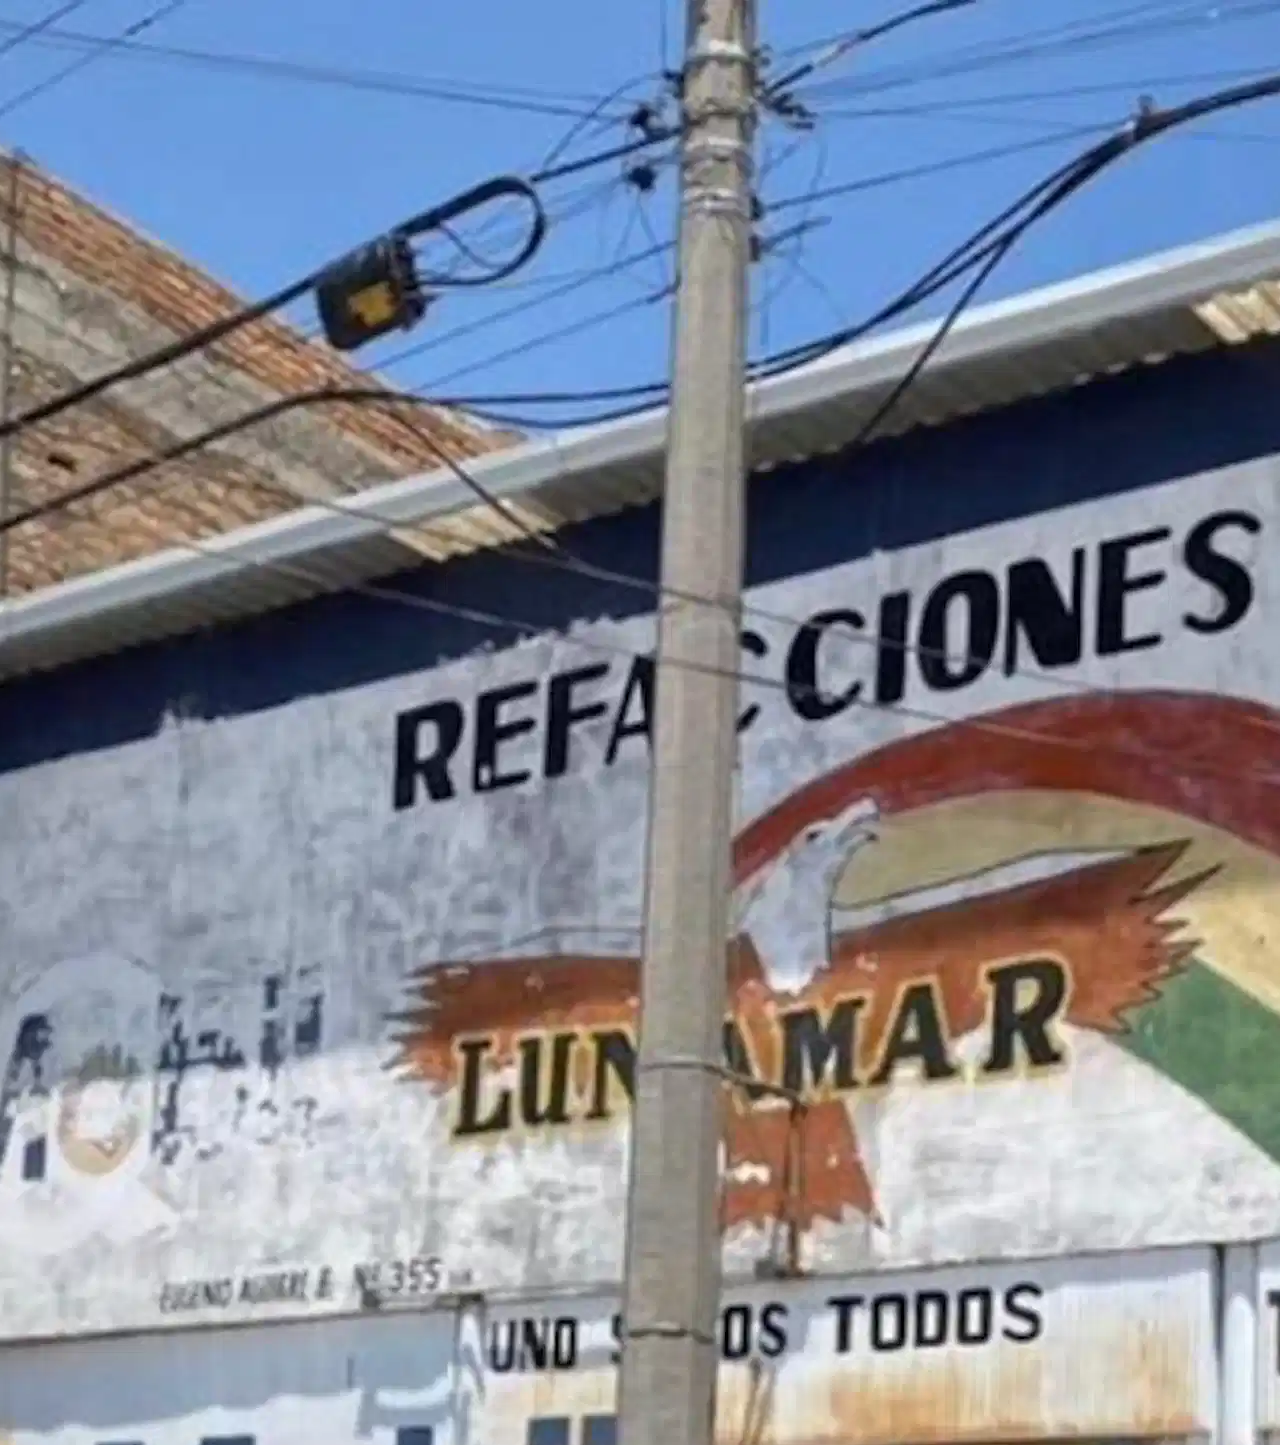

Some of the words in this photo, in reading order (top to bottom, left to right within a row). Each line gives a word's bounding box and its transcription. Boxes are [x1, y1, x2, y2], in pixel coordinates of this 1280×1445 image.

[393, 511, 1262, 810] REFACIONES
[489, 1315, 578, 1373] UNO
[828, 1283, 1043, 1353] TODOS
